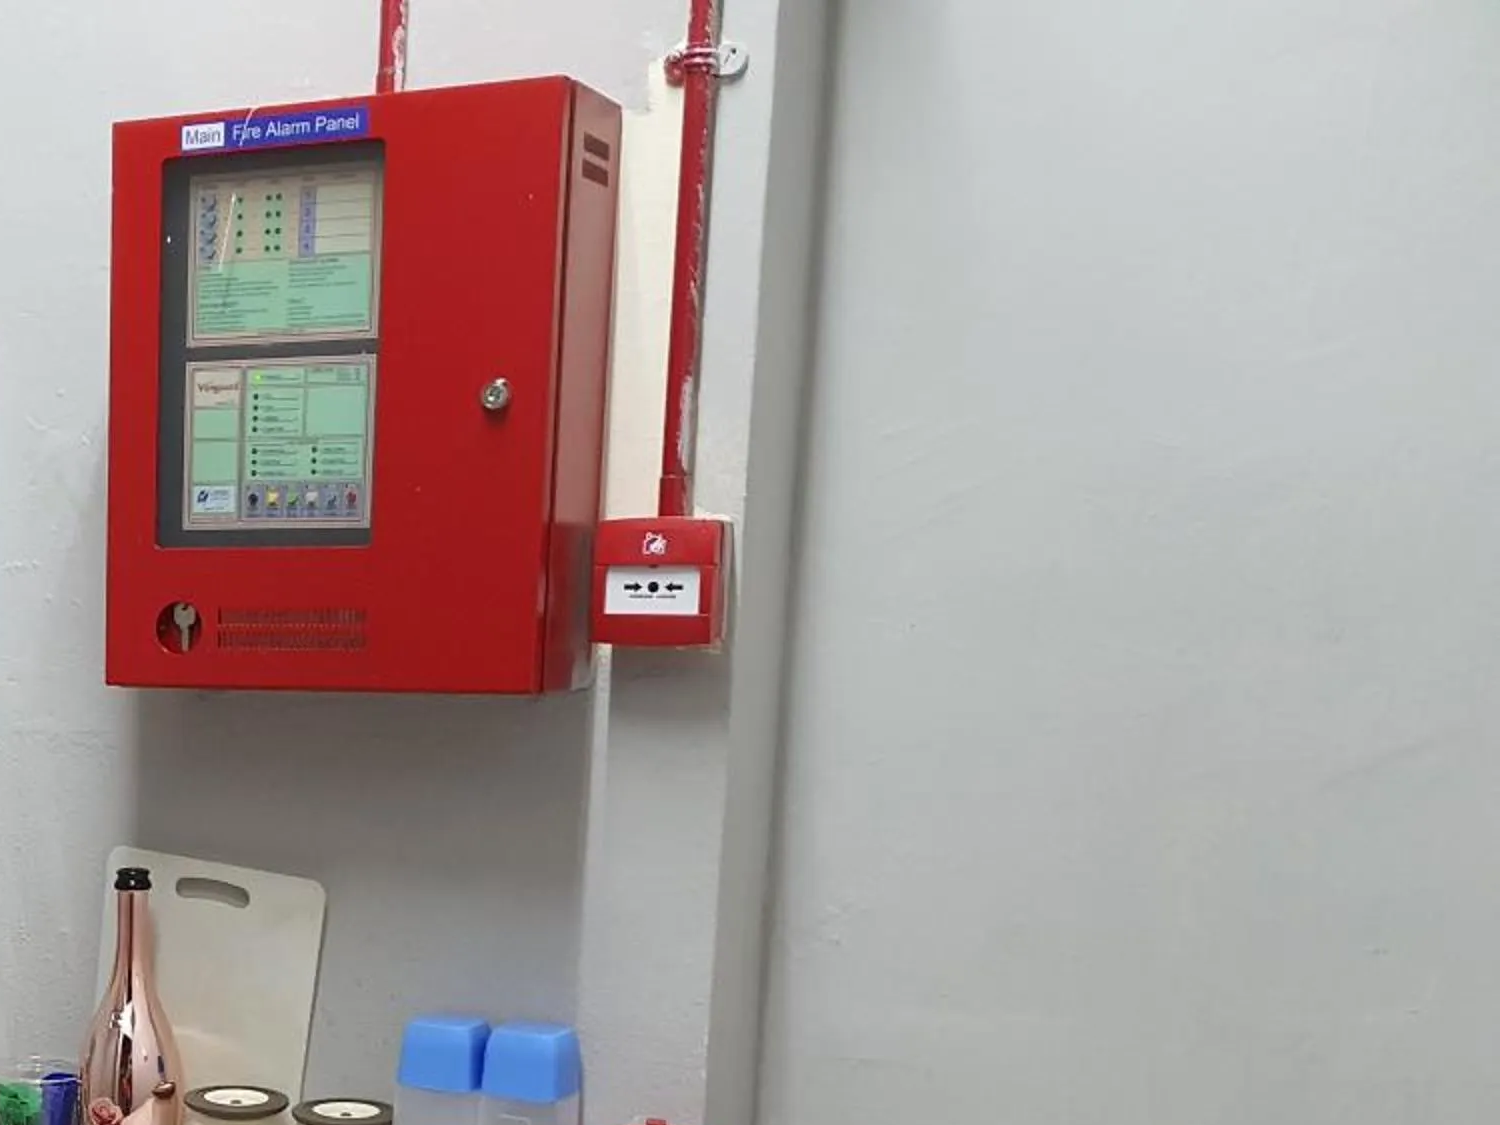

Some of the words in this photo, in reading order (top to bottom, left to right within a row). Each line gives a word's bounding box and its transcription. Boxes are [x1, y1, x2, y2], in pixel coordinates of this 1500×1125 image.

[185, 128, 221, 146] Main
[232, 122, 261, 141] Fire
[265, 119, 311, 138] Alarm
[315, 111, 360, 132] Panel
